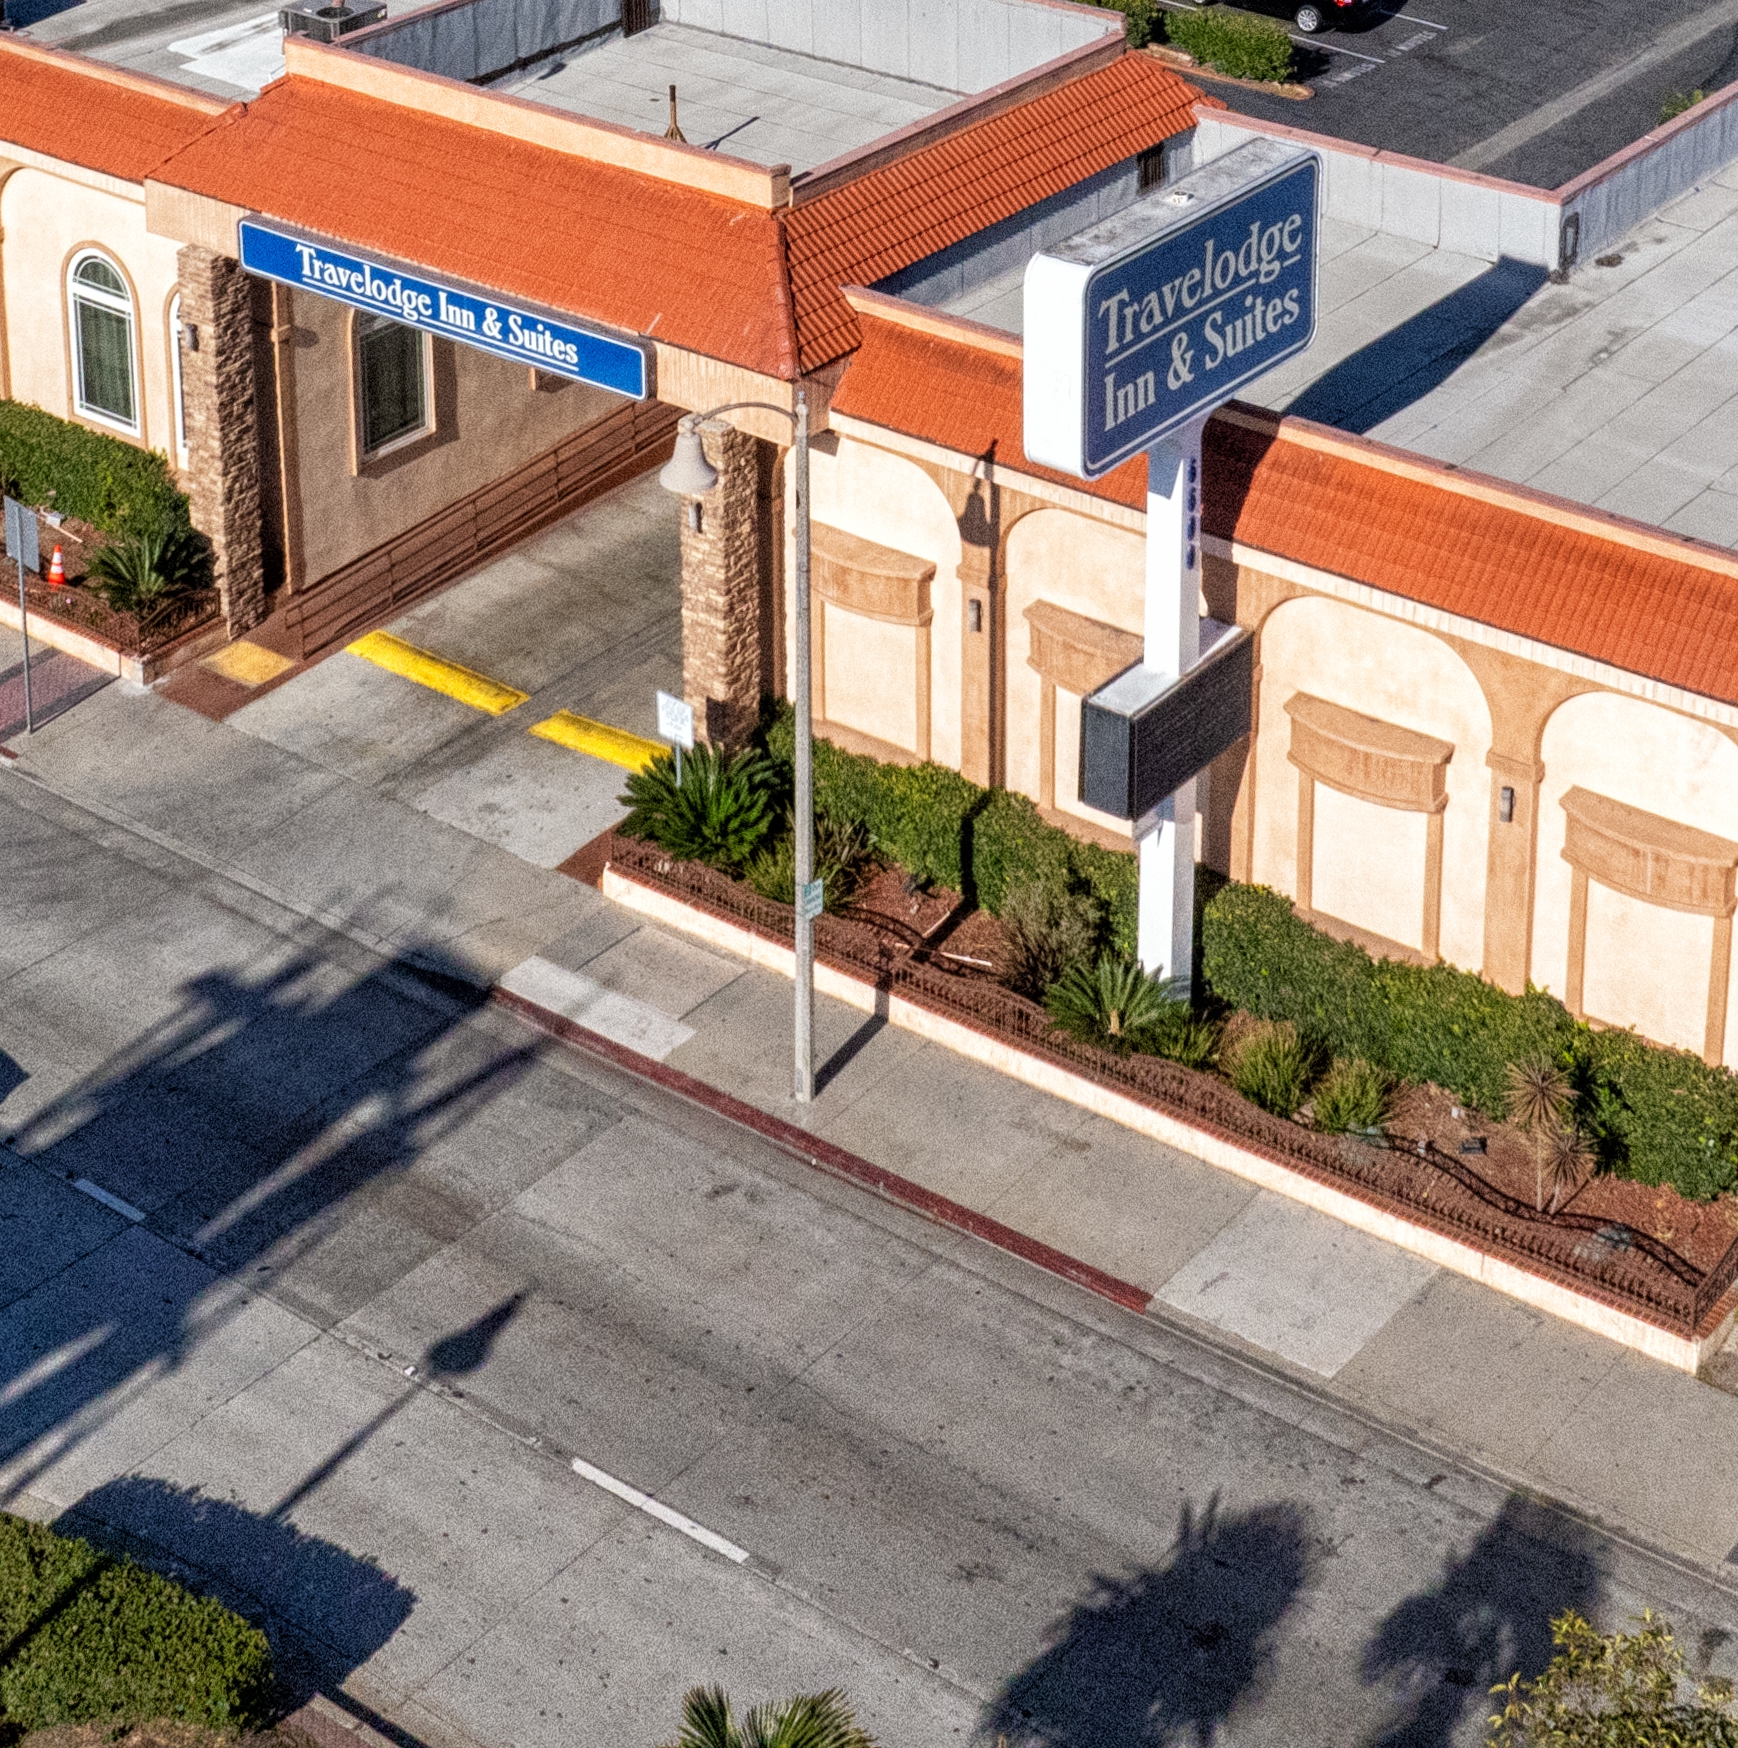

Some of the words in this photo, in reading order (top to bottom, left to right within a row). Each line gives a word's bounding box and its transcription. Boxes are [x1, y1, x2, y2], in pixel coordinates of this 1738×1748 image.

[295, 243, 433, 321] Travelodge
[438, 291, 476, 331] Inn
[481, 307, 503, 340] &
[508, 314, 580, 365] Suites
[1098, 213, 1302, 355] Travelodge
[1104, 370, 1157, 432] Inn
[1166, 331, 1195, 391] &
[1204, 288, 1301, 371] Suites
